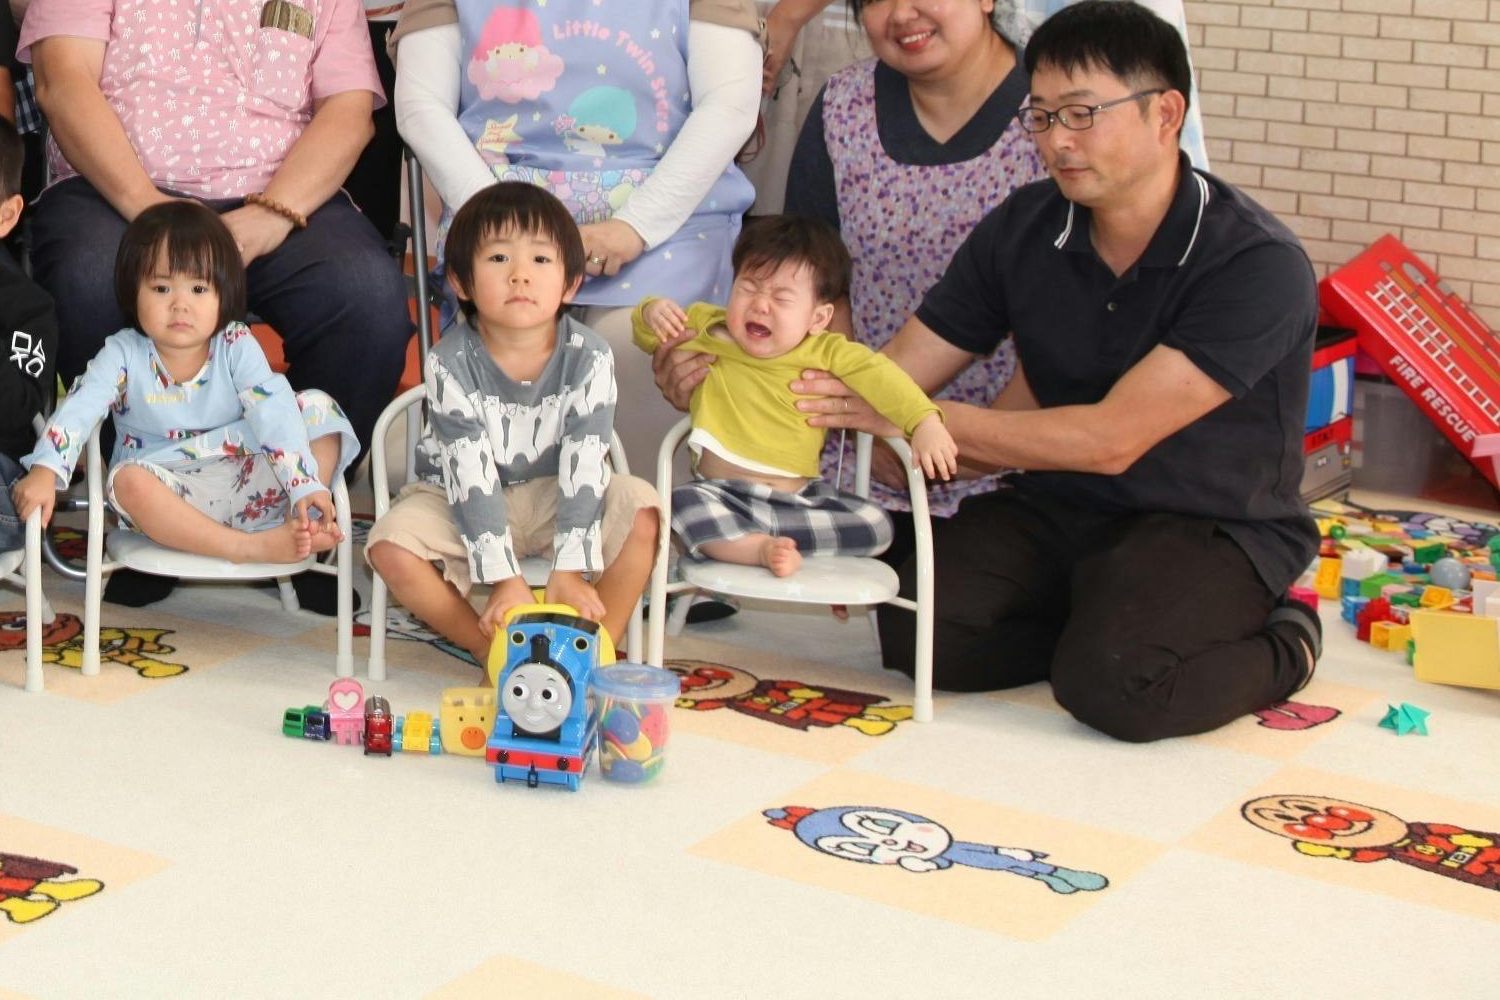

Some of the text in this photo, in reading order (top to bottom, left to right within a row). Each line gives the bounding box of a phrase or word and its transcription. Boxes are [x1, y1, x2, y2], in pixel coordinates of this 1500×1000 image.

[552, 19, 669, 133] Little Twin Stars
[1389, 355, 1477, 443] FIRE RESCUE
